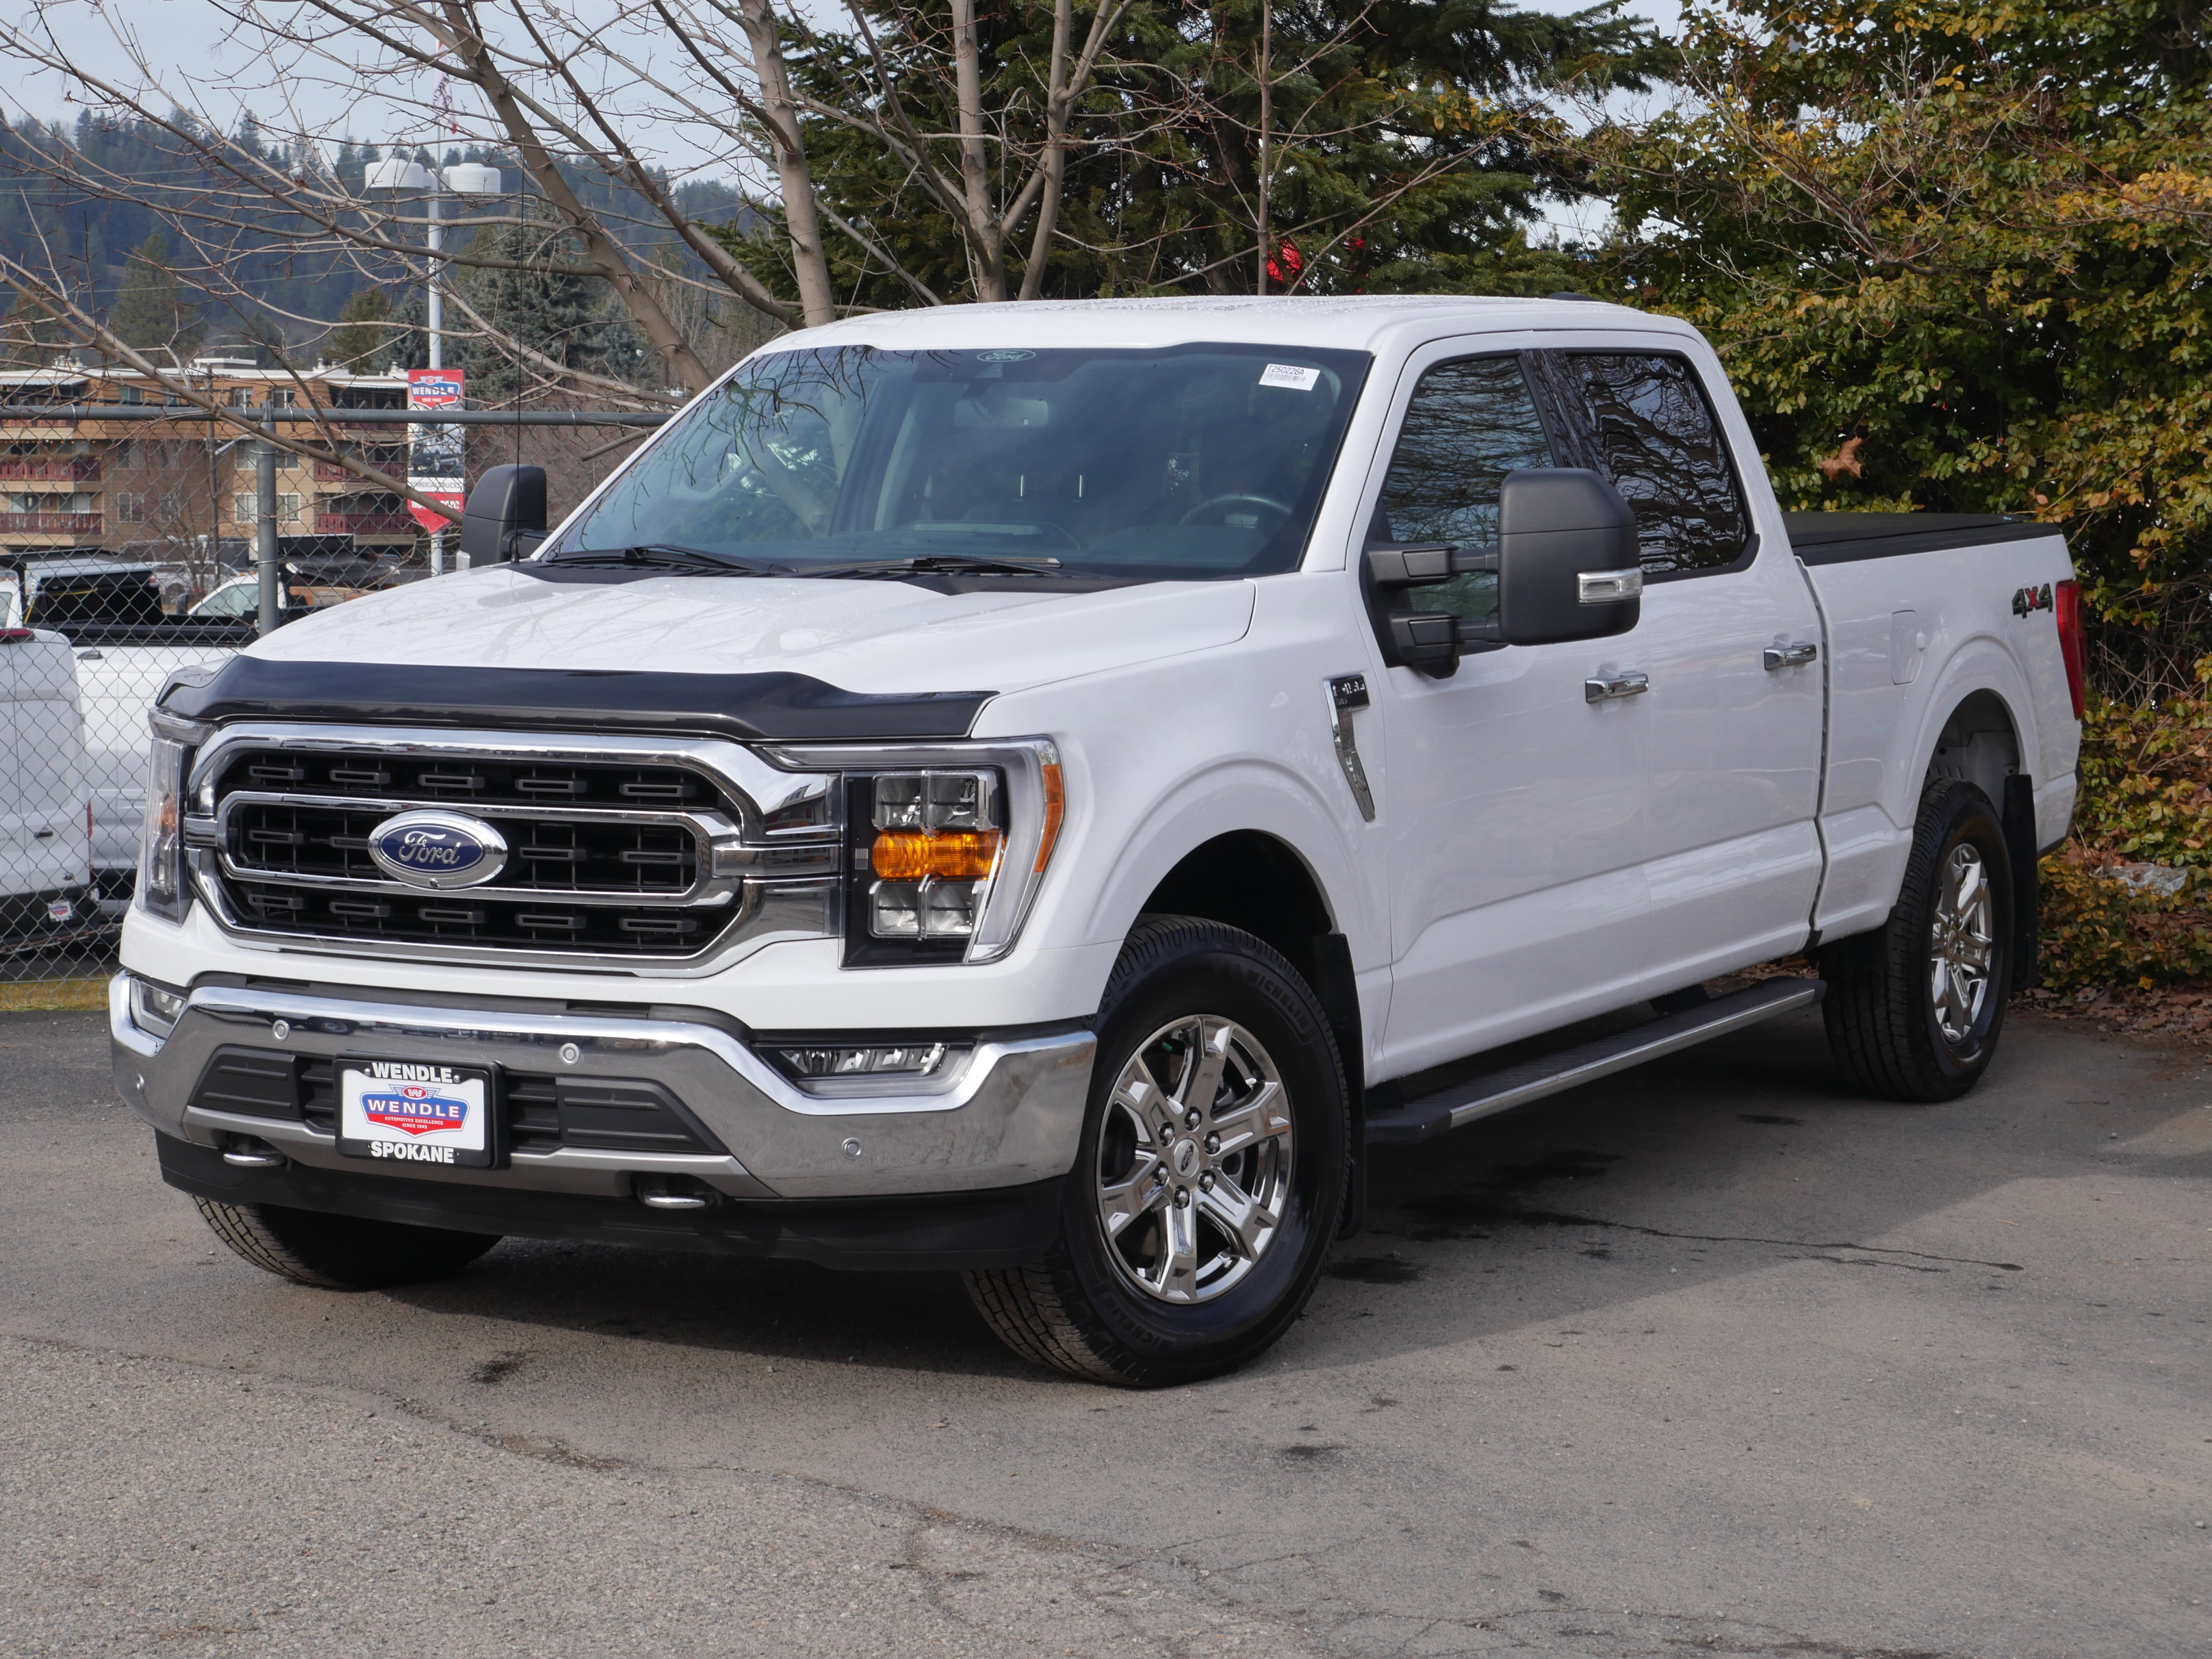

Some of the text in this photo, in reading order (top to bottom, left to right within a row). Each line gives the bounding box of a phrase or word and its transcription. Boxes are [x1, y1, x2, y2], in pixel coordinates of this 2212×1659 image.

[986, 350, 1027, 360] Ford
[1268, 365, 1304, 376] T250226A
[412, 387, 454, 395] WENDLE
[398, 830, 461, 865] Ford
[1246, 968, 1310, 1030] MICHELIN
[372, 1062, 453, 1083] WENDLE
[368, 1099, 460, 1118] WENDLE
[371, 1141, 454, 1163] SPOKANE
